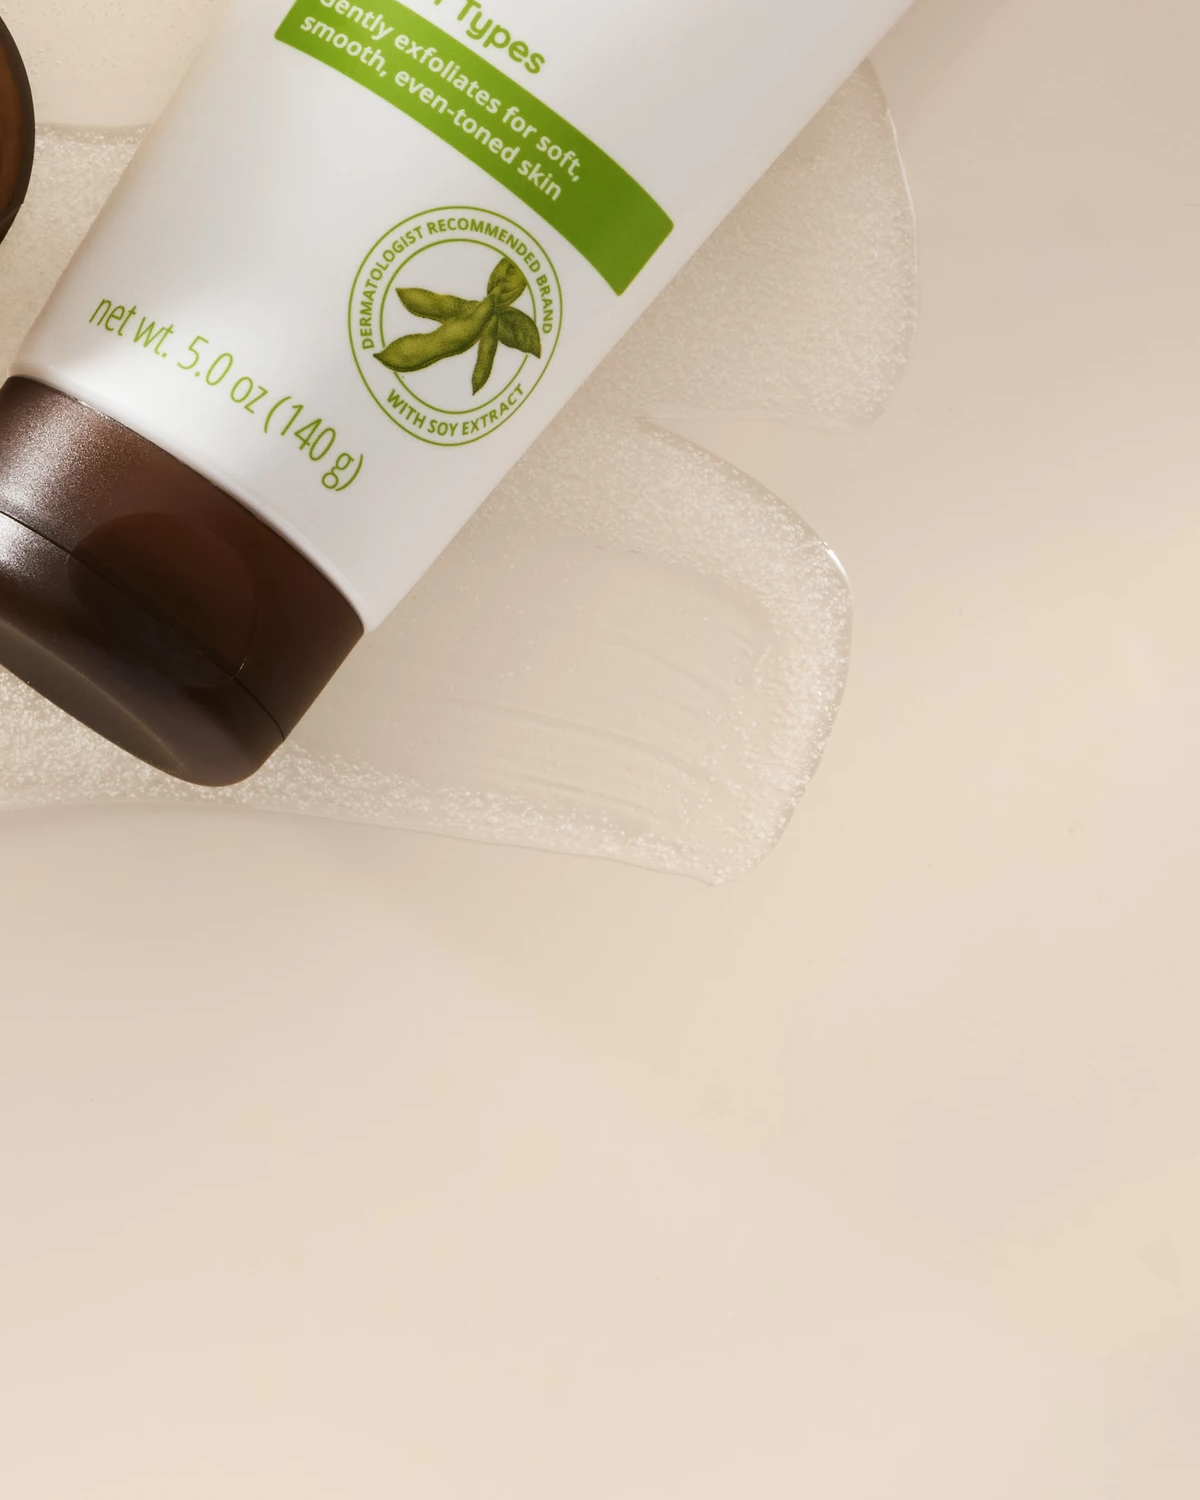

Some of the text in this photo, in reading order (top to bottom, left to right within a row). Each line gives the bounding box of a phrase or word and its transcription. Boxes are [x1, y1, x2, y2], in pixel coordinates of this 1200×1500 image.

[300, 15, 562, 201] smooth, even-toned skin
[394, 33, 501, 114] exfoliates
[501, 107, 537, 139] for
[536, 133, 581, 182] soft,
[359, 218, 553, 350] DERMATOLOGIST RECOMMENDED BRAND
[89, 298, 363, 492] net wt. 5.0 oz (140 g)
[386, 383, 524, 437] WITH SOY EXTRACT
